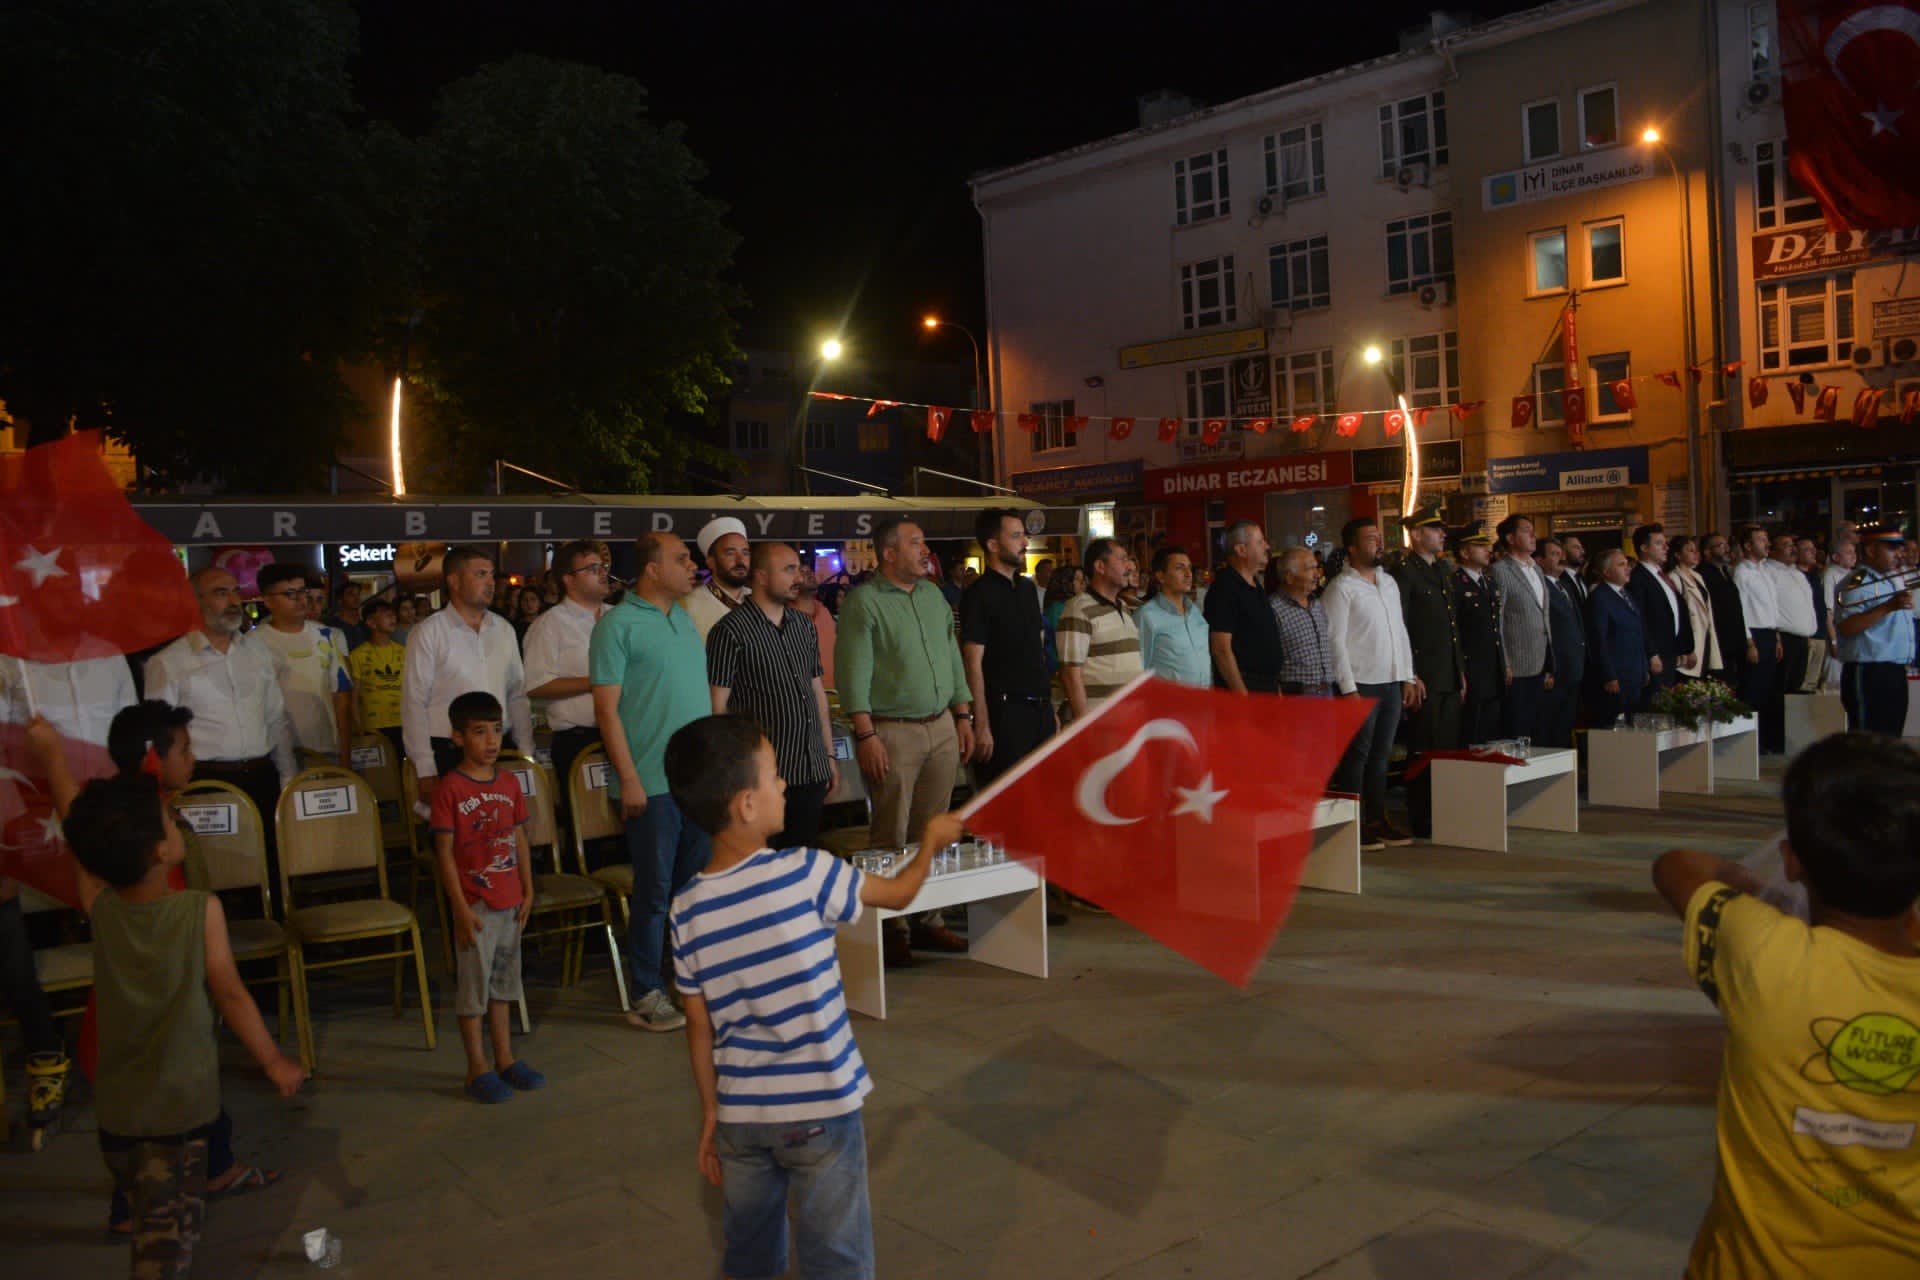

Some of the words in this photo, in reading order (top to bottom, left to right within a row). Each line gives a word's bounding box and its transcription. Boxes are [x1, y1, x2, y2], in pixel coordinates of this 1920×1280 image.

[1523, 168, 1545, 192] İYİ
[1163, 470, 1221, 495] DİNAR
[1227, 460, 1328, 488] ECZANESİ
[1566, 474, 1604, 486] Allianz
[1850, 1026, 1917, 1052] FUTURE
[1846, 1043, 1914, 1066] WORLD
